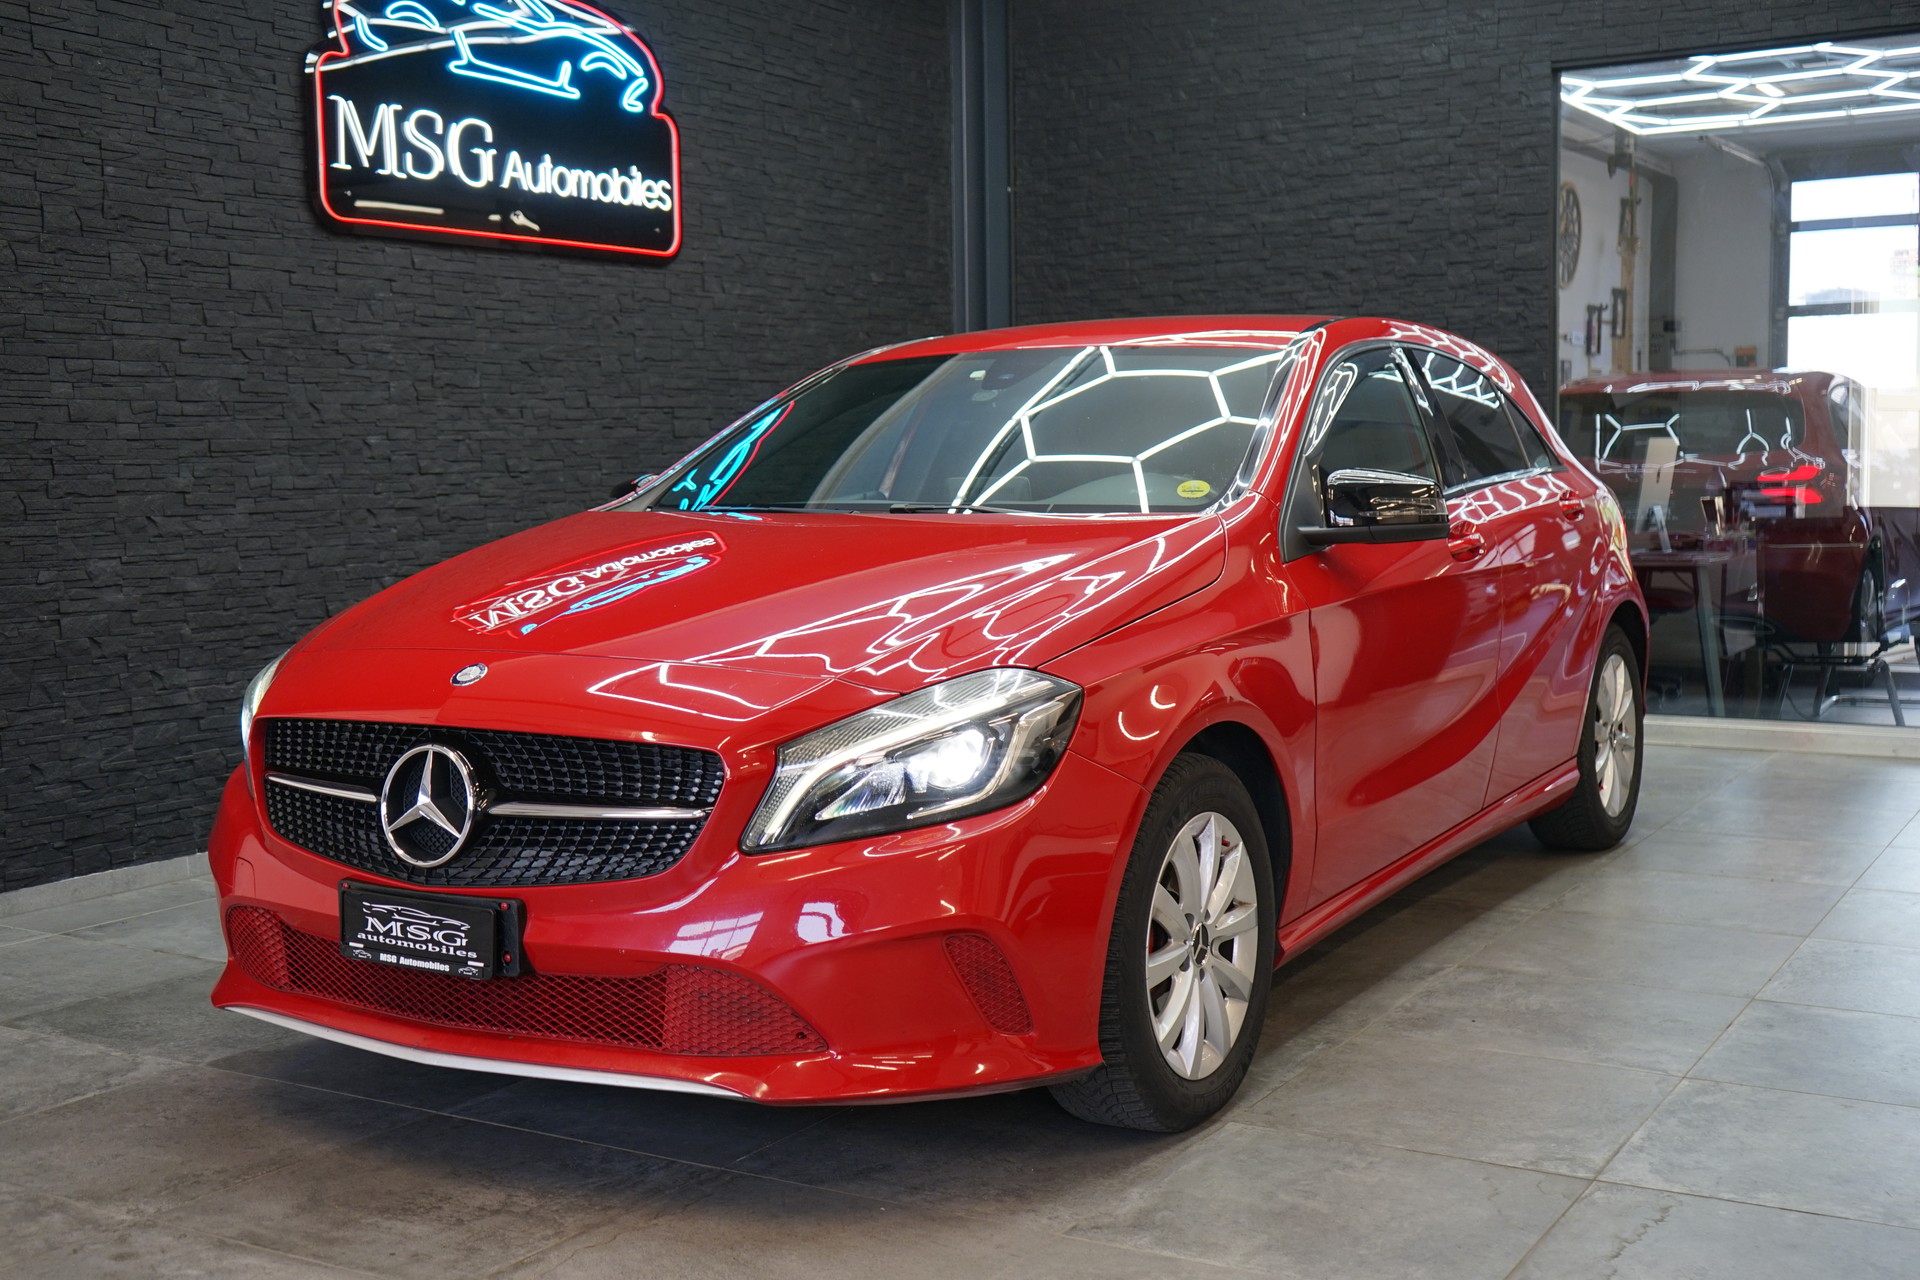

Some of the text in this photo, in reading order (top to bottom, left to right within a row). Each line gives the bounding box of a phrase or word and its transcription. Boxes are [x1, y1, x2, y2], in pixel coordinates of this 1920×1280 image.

[327, 95, 672, 212] MSG Automobiles
[357, 932, 477, 959] automobiles
[365, 916, 468, 947] MSG
[379, 953, 450, 972] MSG Automobiles
